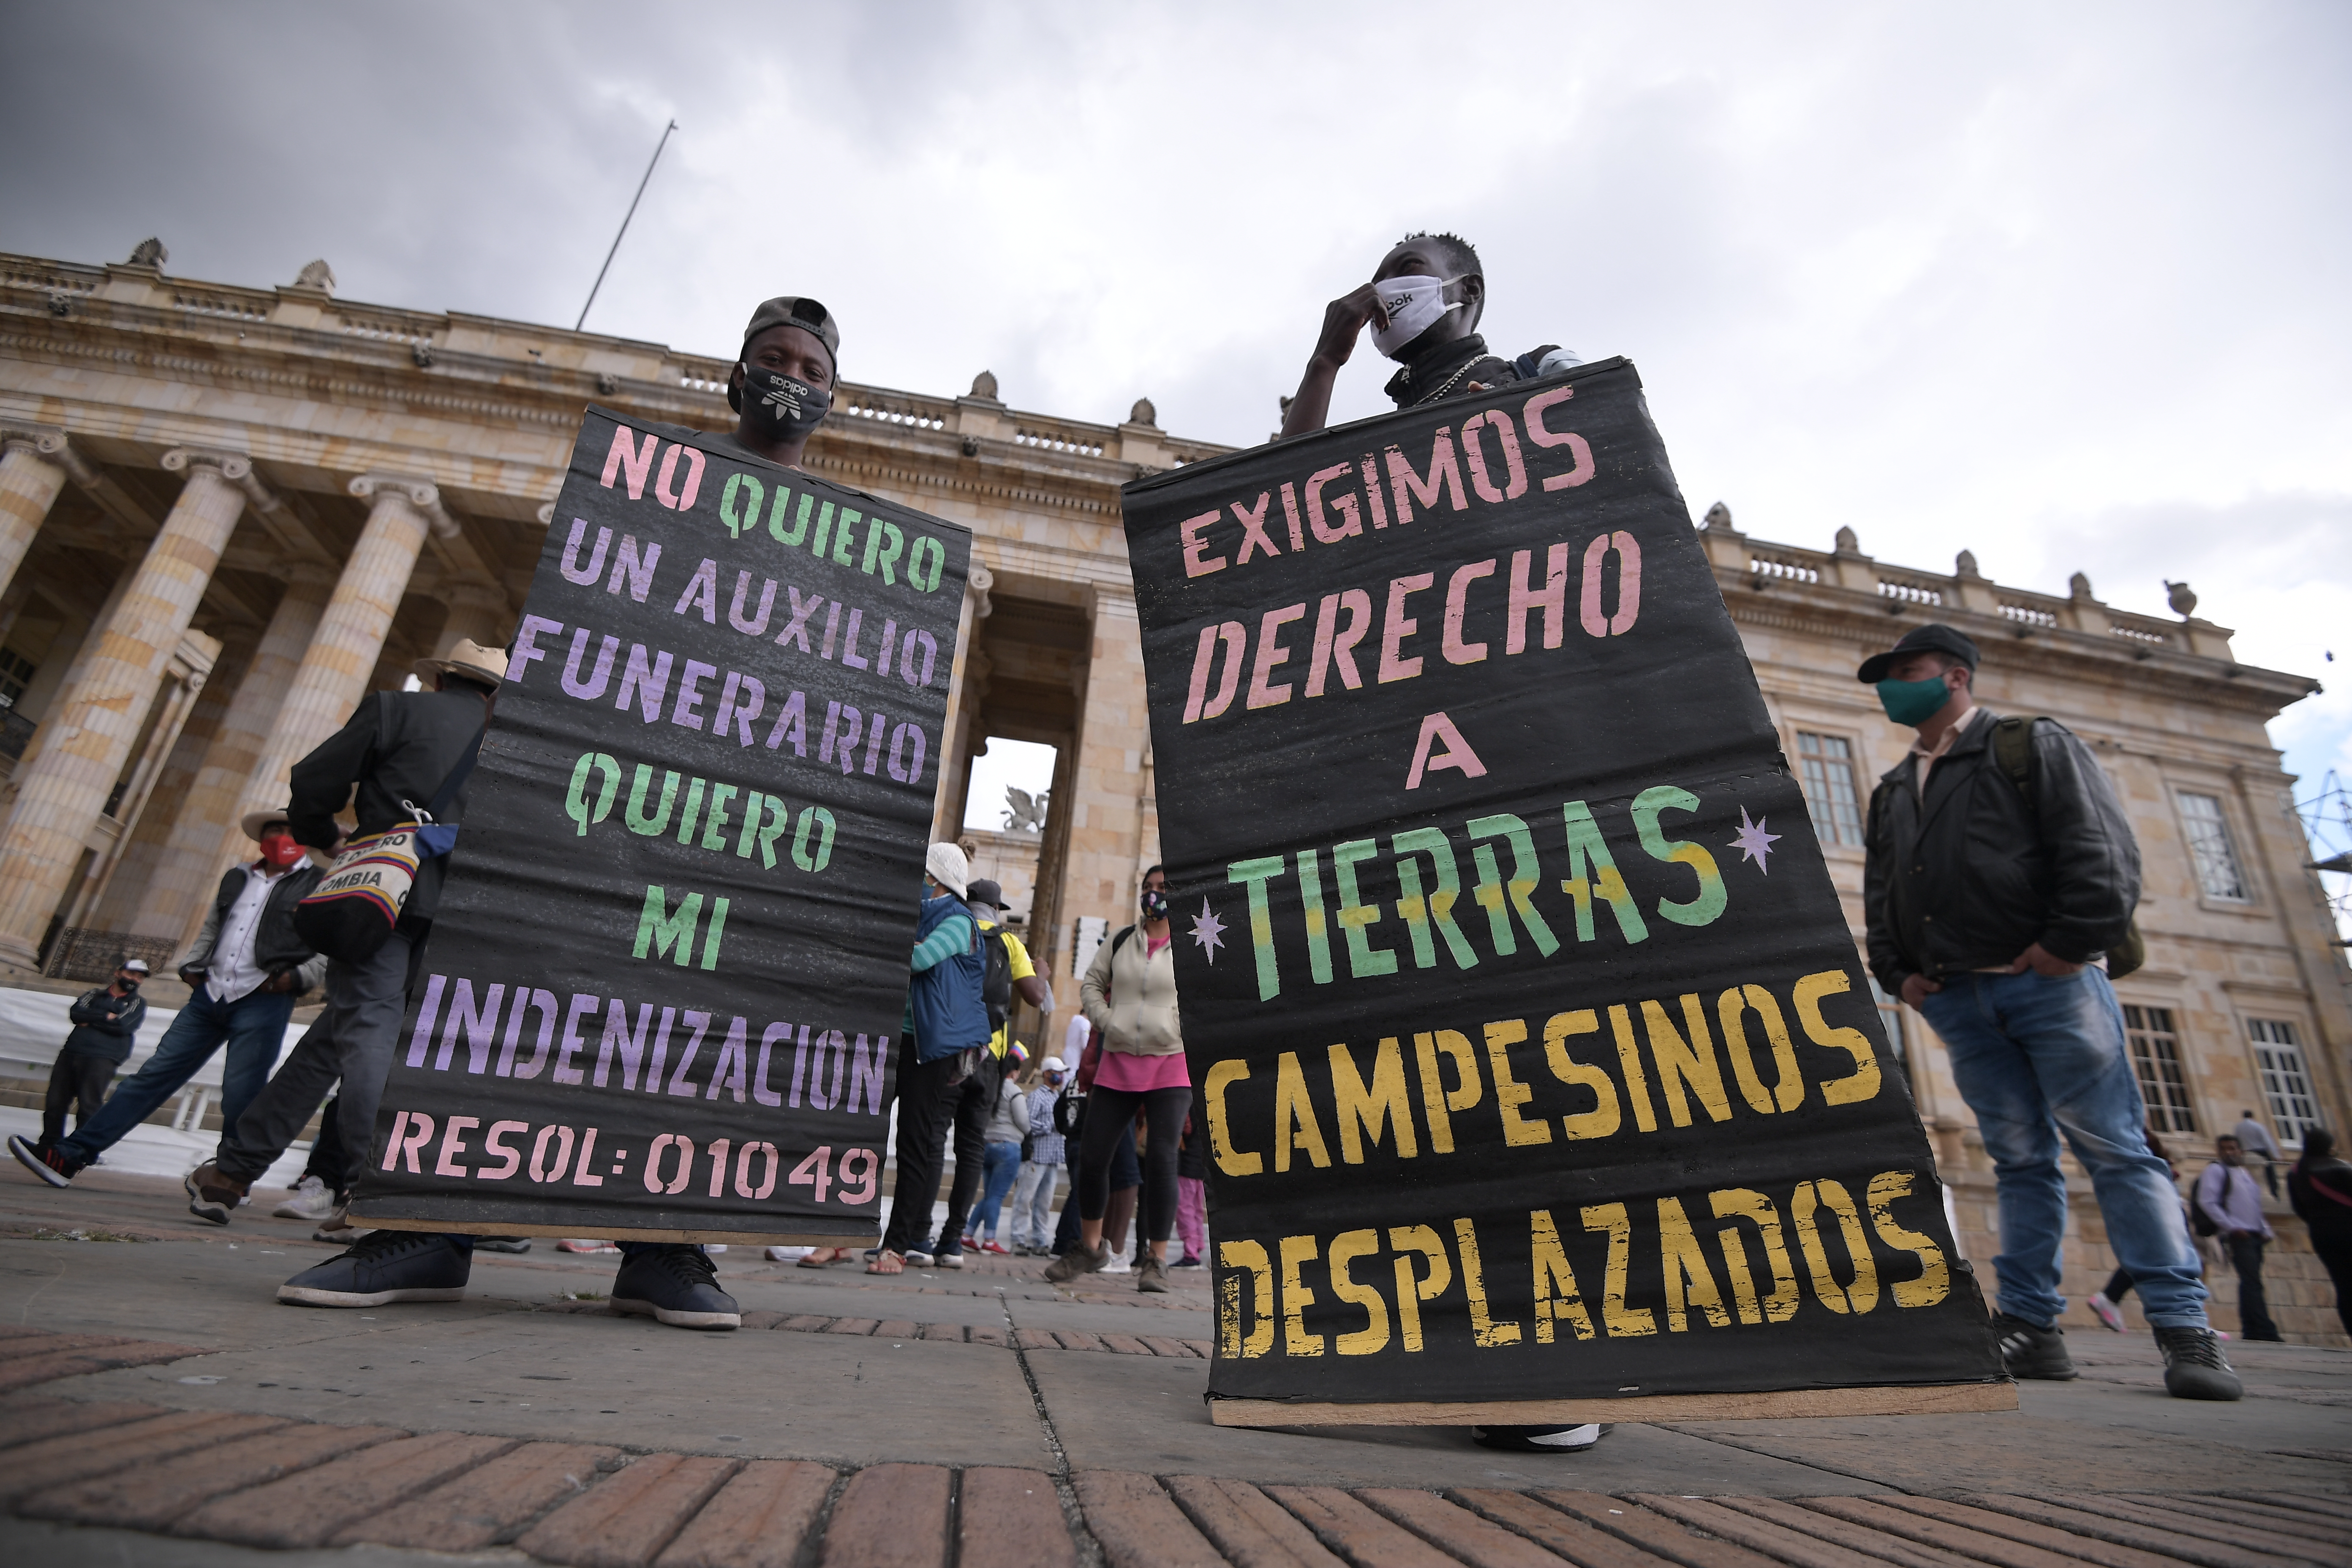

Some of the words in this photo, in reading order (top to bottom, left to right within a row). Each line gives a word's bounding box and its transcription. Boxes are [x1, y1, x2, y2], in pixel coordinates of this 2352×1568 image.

[770, 375, 808, 396] adidas
[600, 425, 706, 512] NO
[719, 473, 945, 593] QUIERO
[1180, 385, 1595, 578] EXIGIMOS
[560, 517, 662, 603] UN
[673, 558, 938, 687] AUXILIO
[1182, 530, 1642, 724] DERECHO
[505, 613, 926, 784] FUNERARIO
[1405, 711, 1488, 790] A
[565, 752, 836, 873] QUIERO
[1227, 785, 1728, 1002] TIERRAS
[632, 885, 730, 971] MI
[406, 974, 889, 1116] INDENIZACION
[1204, 969, 1882, 1177] CAMPESINOS
[381, 1111, 627, 1186] RESOL:
[644, 1133, 878, 1205] 01049
[1219, 1171, 1950, 1360] DESPLAZADOS
